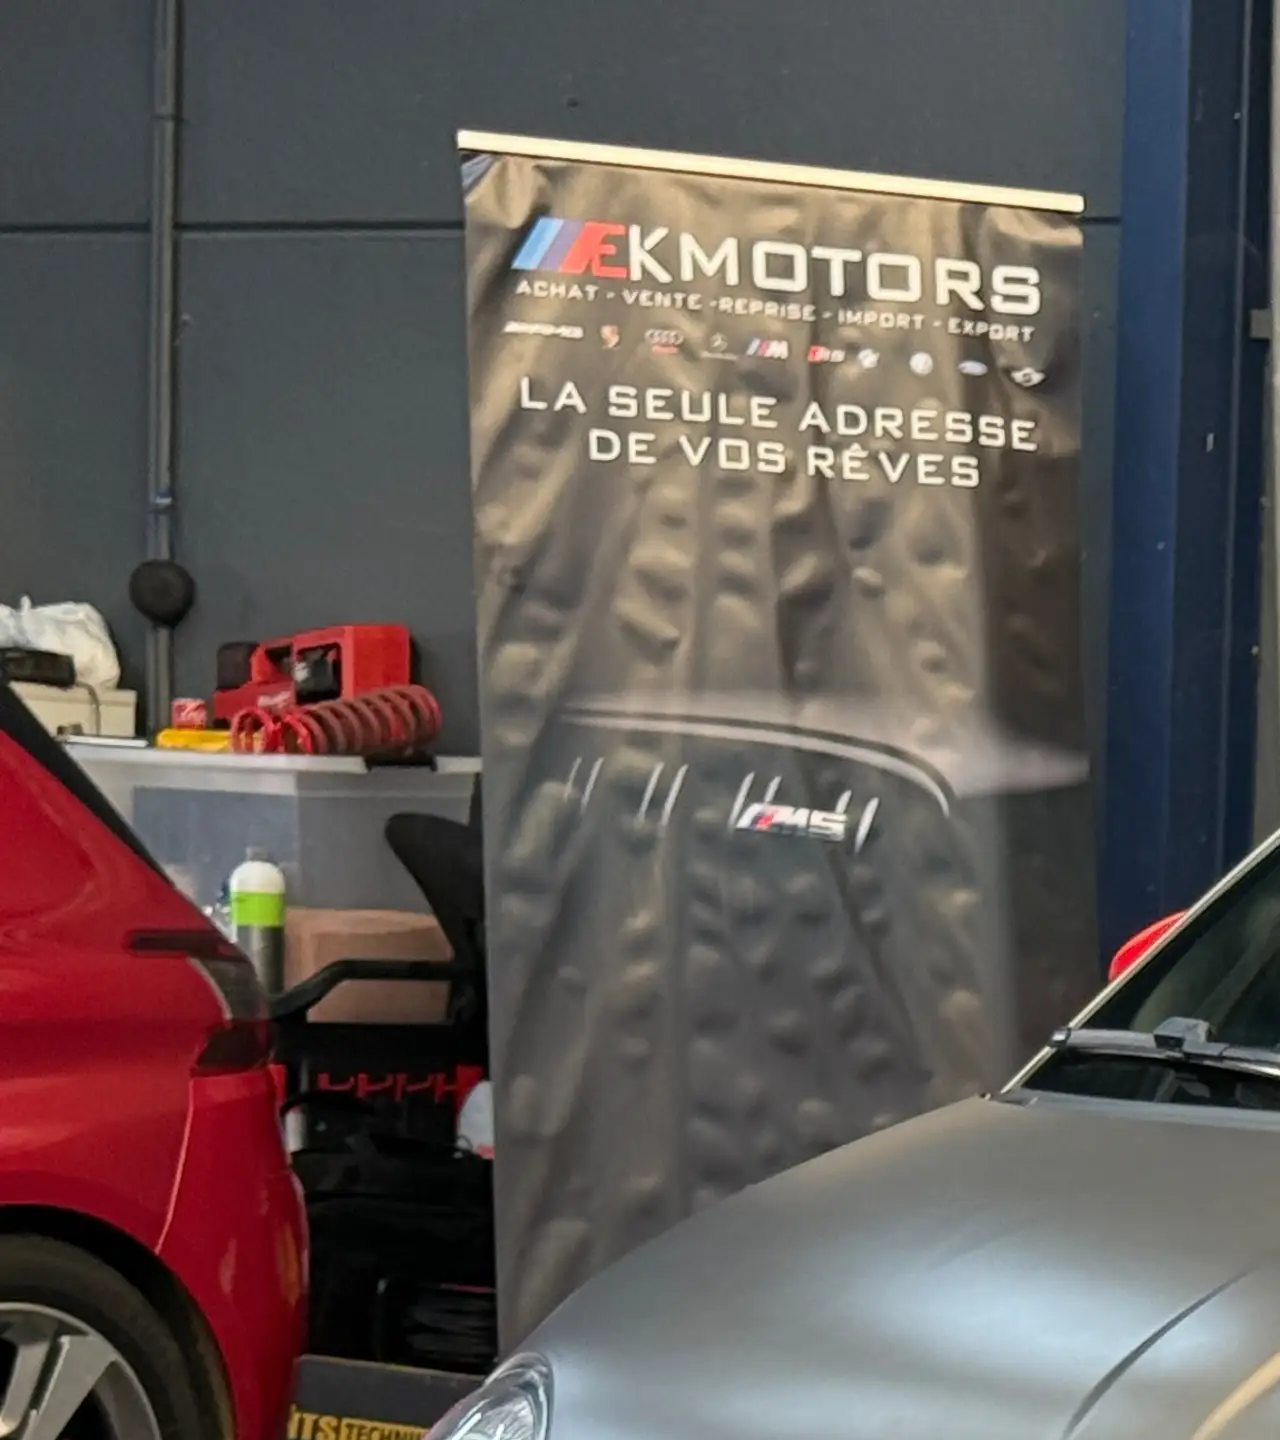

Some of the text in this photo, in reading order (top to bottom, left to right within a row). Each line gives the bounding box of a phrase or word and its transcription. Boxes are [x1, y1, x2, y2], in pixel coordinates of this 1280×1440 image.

[515, 279, 599, 302] ACHAT
[621, 288, 703, 311] VENTE
[838, 309, 926, 331] IMPORT
[947, 316, 1035, 343] EXPORT
[520, 376, 1038, 452] LA SEULE ADRESSE
[588, 427, 980, 488] DE VOS RÊVES
